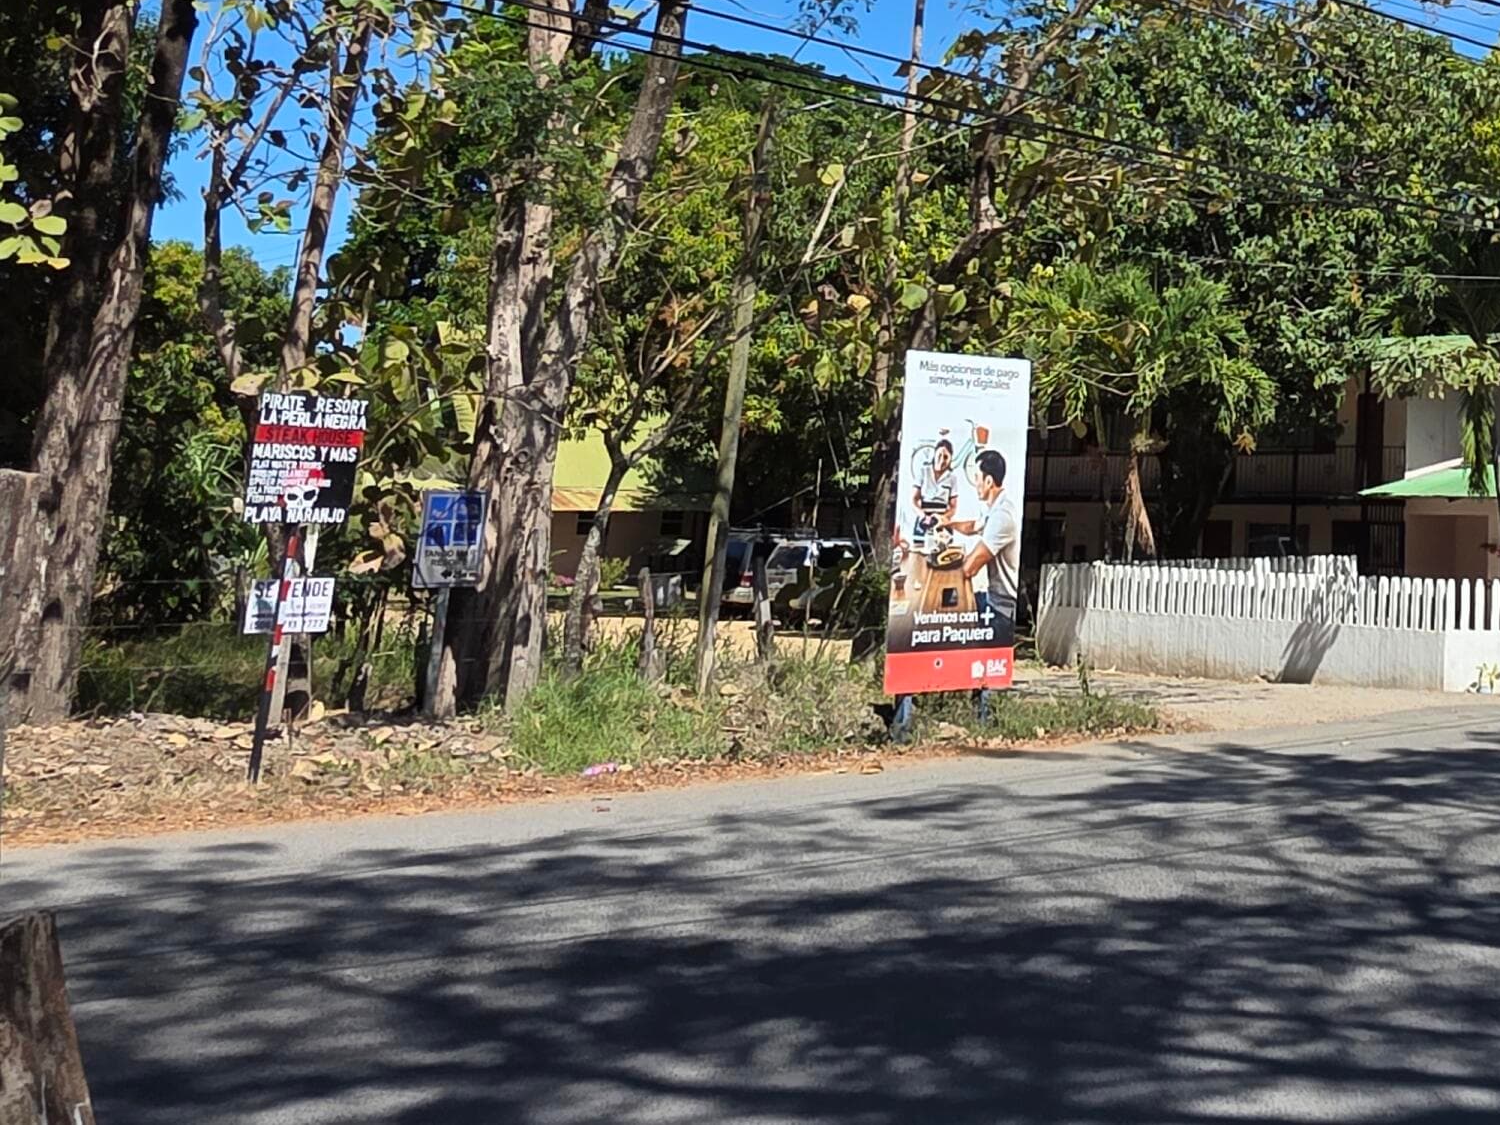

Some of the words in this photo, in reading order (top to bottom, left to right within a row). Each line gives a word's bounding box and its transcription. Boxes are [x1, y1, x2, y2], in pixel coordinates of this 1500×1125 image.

[940, 363, 982, 376] opciones
[983, 365, 996, 376] de
[997, 369, 1020, 381] pago
[928, 374, 965, 386] simples
[965, 378, 973, 389] y
[972, 377, 1011, 391] digitales
[262, 393, 306, 411] PIRATE
[315, 397, 368, 414] RESORT
[265, 426, 308, 441] STEAK
[313, 429, 353, 444] HOUSE
[252, 443, 317, 460] MARISCOS
[319, 445, 329, 462] Y
[329, 447, 358, 463] MAS
[243, 506, 283, 524] PLAYA
[286, 507, 346, 524] NARANJO
[254, 581, 277, 598] SE
[913, 610, 958, 625] Venimos
[959, 612, 978, 623] con
[912, 630, 940, 646] para
[942, 627, 993, 644] Paquera
